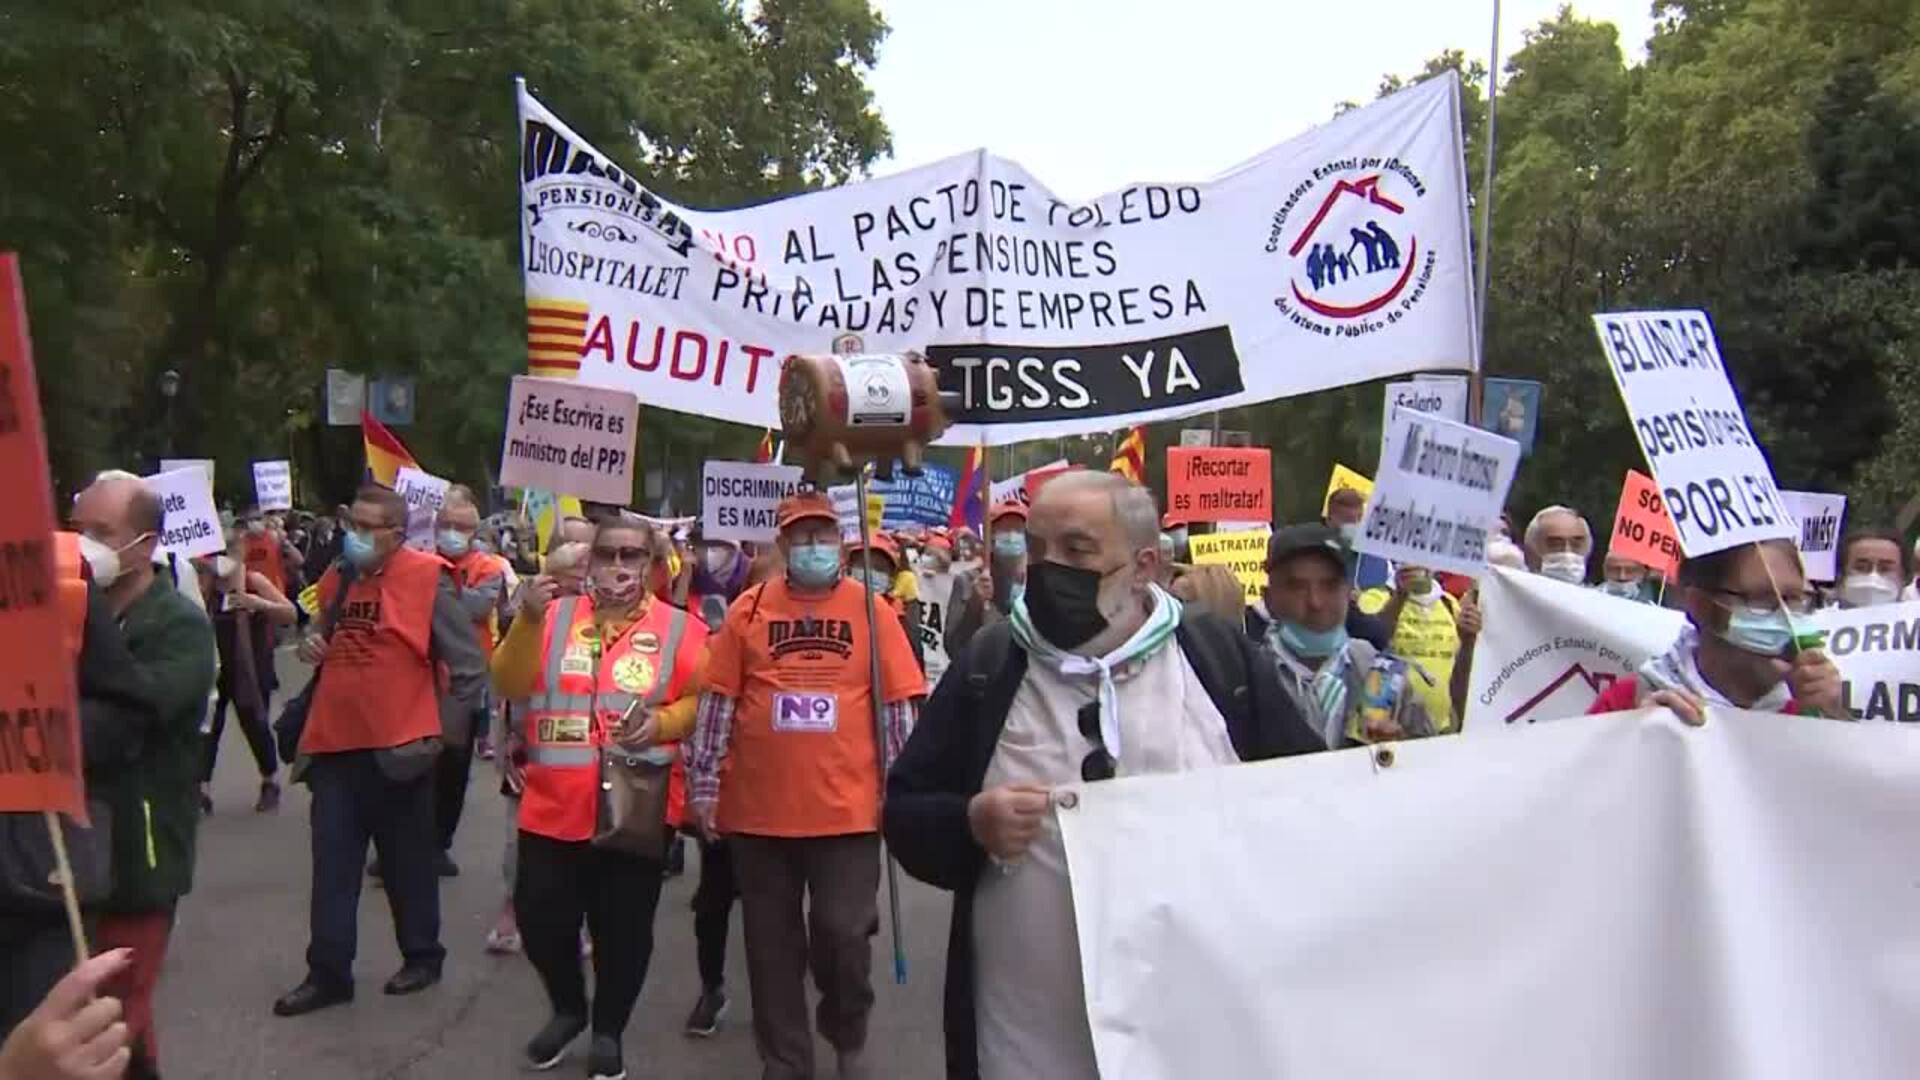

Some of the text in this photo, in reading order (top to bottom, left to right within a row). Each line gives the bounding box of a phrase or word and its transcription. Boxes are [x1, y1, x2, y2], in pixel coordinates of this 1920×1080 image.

[1313, 157, 1358, 181] Estatal
[1360, 158, 1381, 170] por
[784, 226, 835, 264] AL
[853, 179, 979, 251] PACTO
[990, 180, 1025, 222] DE
[1049, 184, 1201, 228] TOLEDO
[835, 252, 921, 302] LAS
[932, 231, 1117, 279] PENSIONES
[713, 268, 919, 334] PRIVADAS
[930, 289, 948, 328] Y
[966, 287, 1008, 328] DE
[1018, 279, 1207, 330] EMPRESA
[1387, 312, 1403, 324] de
[1401, 251, 1436, 310] Pensiones
[582, 315, 778, 394] AUDIT
[1122, 347, 1201, 398] YA
[608, 414, 625, 434] es
[510, 435, 627, 475] ministro del PP?
[1186, 456, 1252, 480] ¡Recortar
[718, 506, 739, 526] ES
[1175, 488, 1264, 510] es maltratar!
[1638, 489, 1669, 516] SO
[1664, 478, 1745, 543] POR
[1195, 538, 1265, 557] MALTRATAR
[1618, 516, 1646, 545] NO
[1820, 617, 1920, 657] ORM
[1479, 643, 1552, 706] Coordinadora
[1553, 636, 1597, 650] Estatal
[1598, 647, 1622, 663] por
